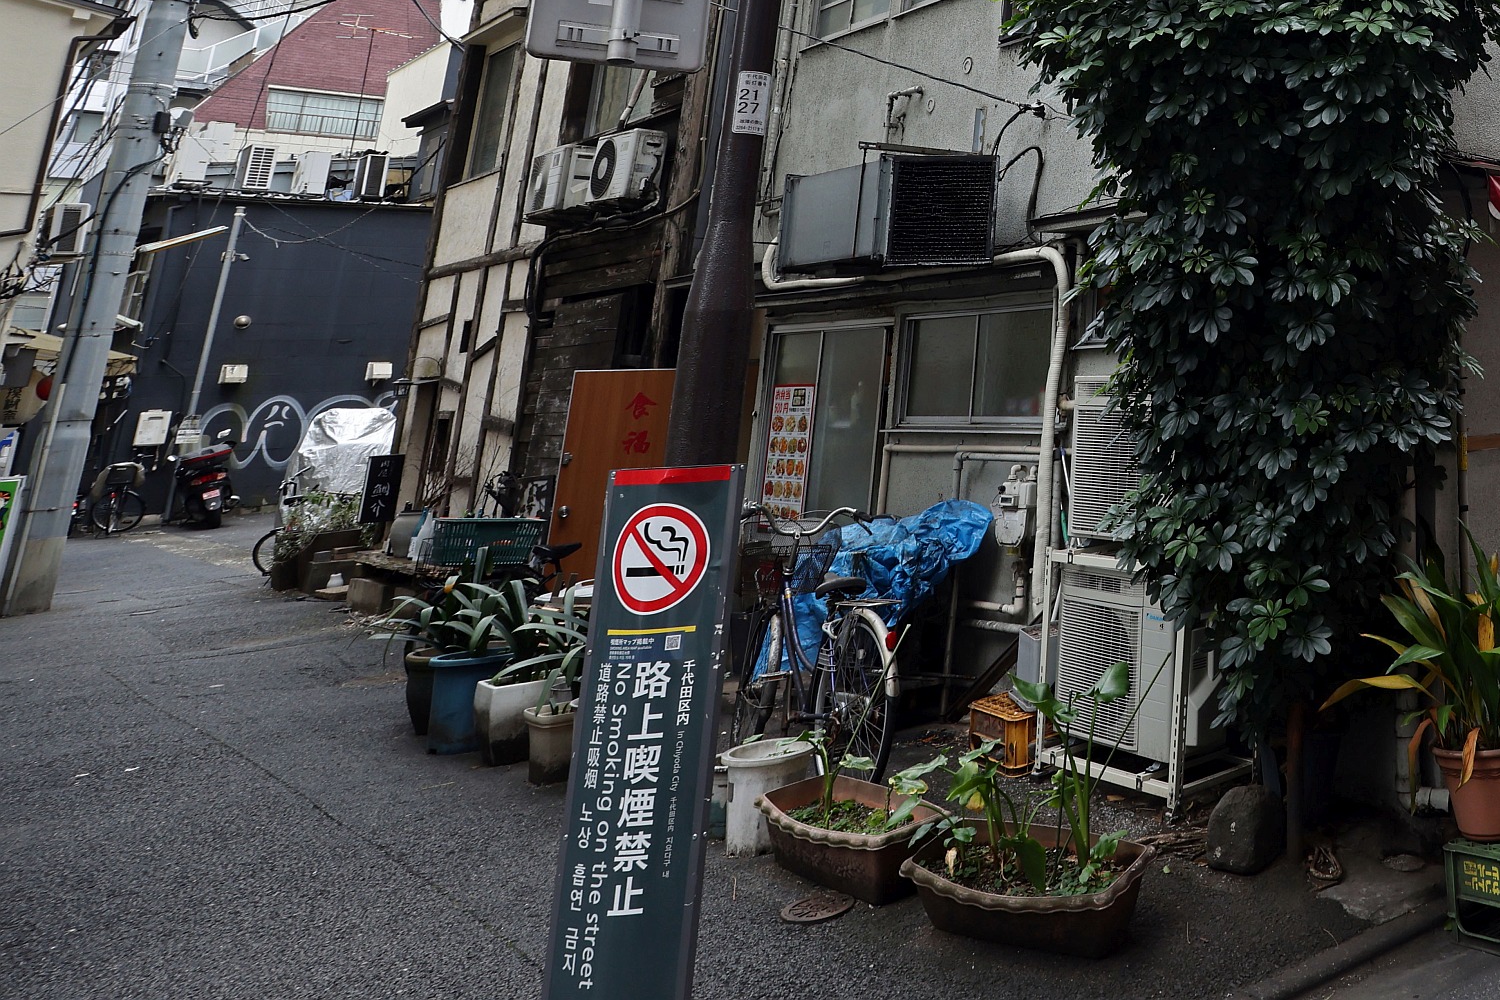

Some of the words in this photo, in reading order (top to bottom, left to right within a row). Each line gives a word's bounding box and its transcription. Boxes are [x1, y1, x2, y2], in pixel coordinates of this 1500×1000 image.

[737, 101, 760, 114] 27
[739, 88, 759, 101] 21
[622, 391, 657, 455] 食福
[615, 663, 633, 696] No
[677, 659, 697, 727] 千代田区内
[583, 662, 613, 790] 道路禁止吸烟
[676, 730, 685, 739] In
[596, 704, 627, 811] Smoking
[672, 740, 684, 774] Chiyoda
[606, 660, 672, 917] 路上喫煙禁止
[669, 776, 680, 792] City
[577, 802, 594, 849] 노상
[594, 820, 609, 853] on
[570, 863, 587, 912] 흡연
[588, 861, 609, 905] the
[1477, 863, 1500, 881] ビール
[562, 927, 579, 976] 금지
[578, 913, 600, 990] street
